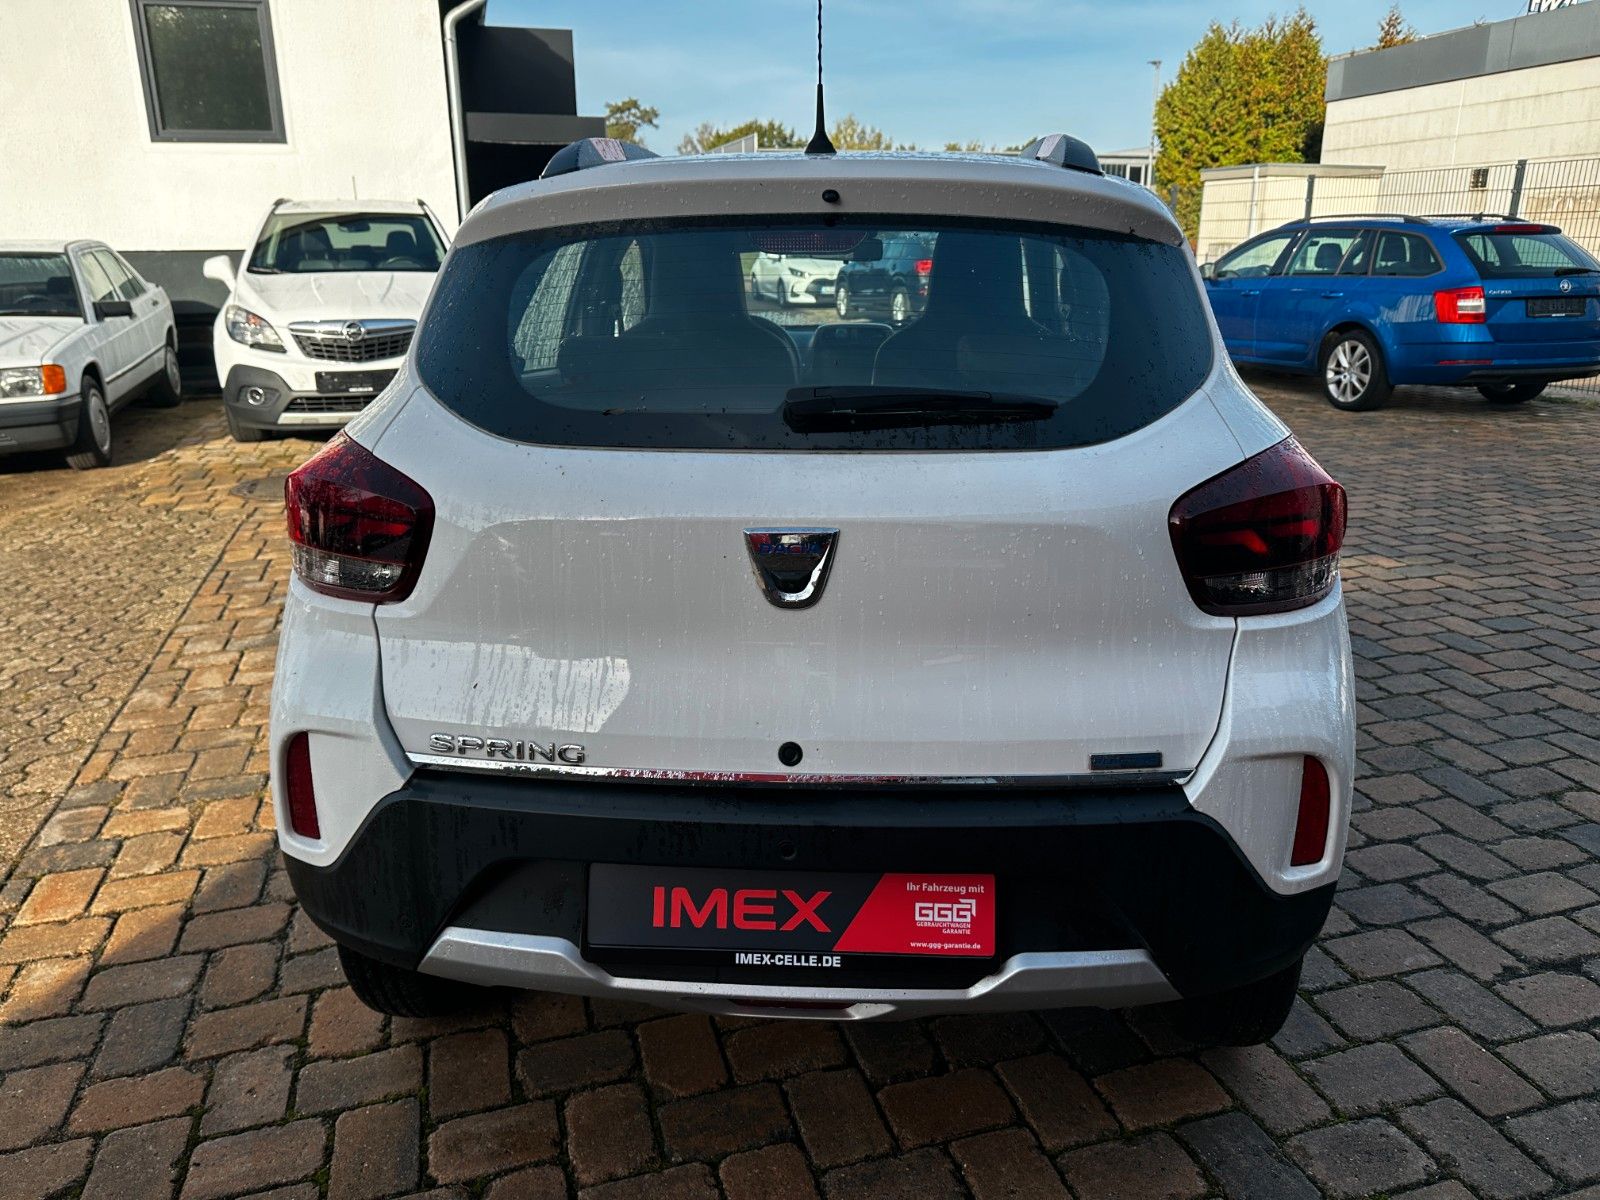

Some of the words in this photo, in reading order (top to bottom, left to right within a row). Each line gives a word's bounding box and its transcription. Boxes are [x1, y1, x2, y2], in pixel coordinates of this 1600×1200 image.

[429, 733, 586, 764] SPRING
[906, 882, 920, 891] Ihr
[922, 883, 966, 894] Fahrzeug
[968, 884, 985, 893] mit
[652, 886, 832, 933] IMEX
[914, 902, 971, 922] GGG
[734, 952, 842, 968] IMEX-CELLE.DE
